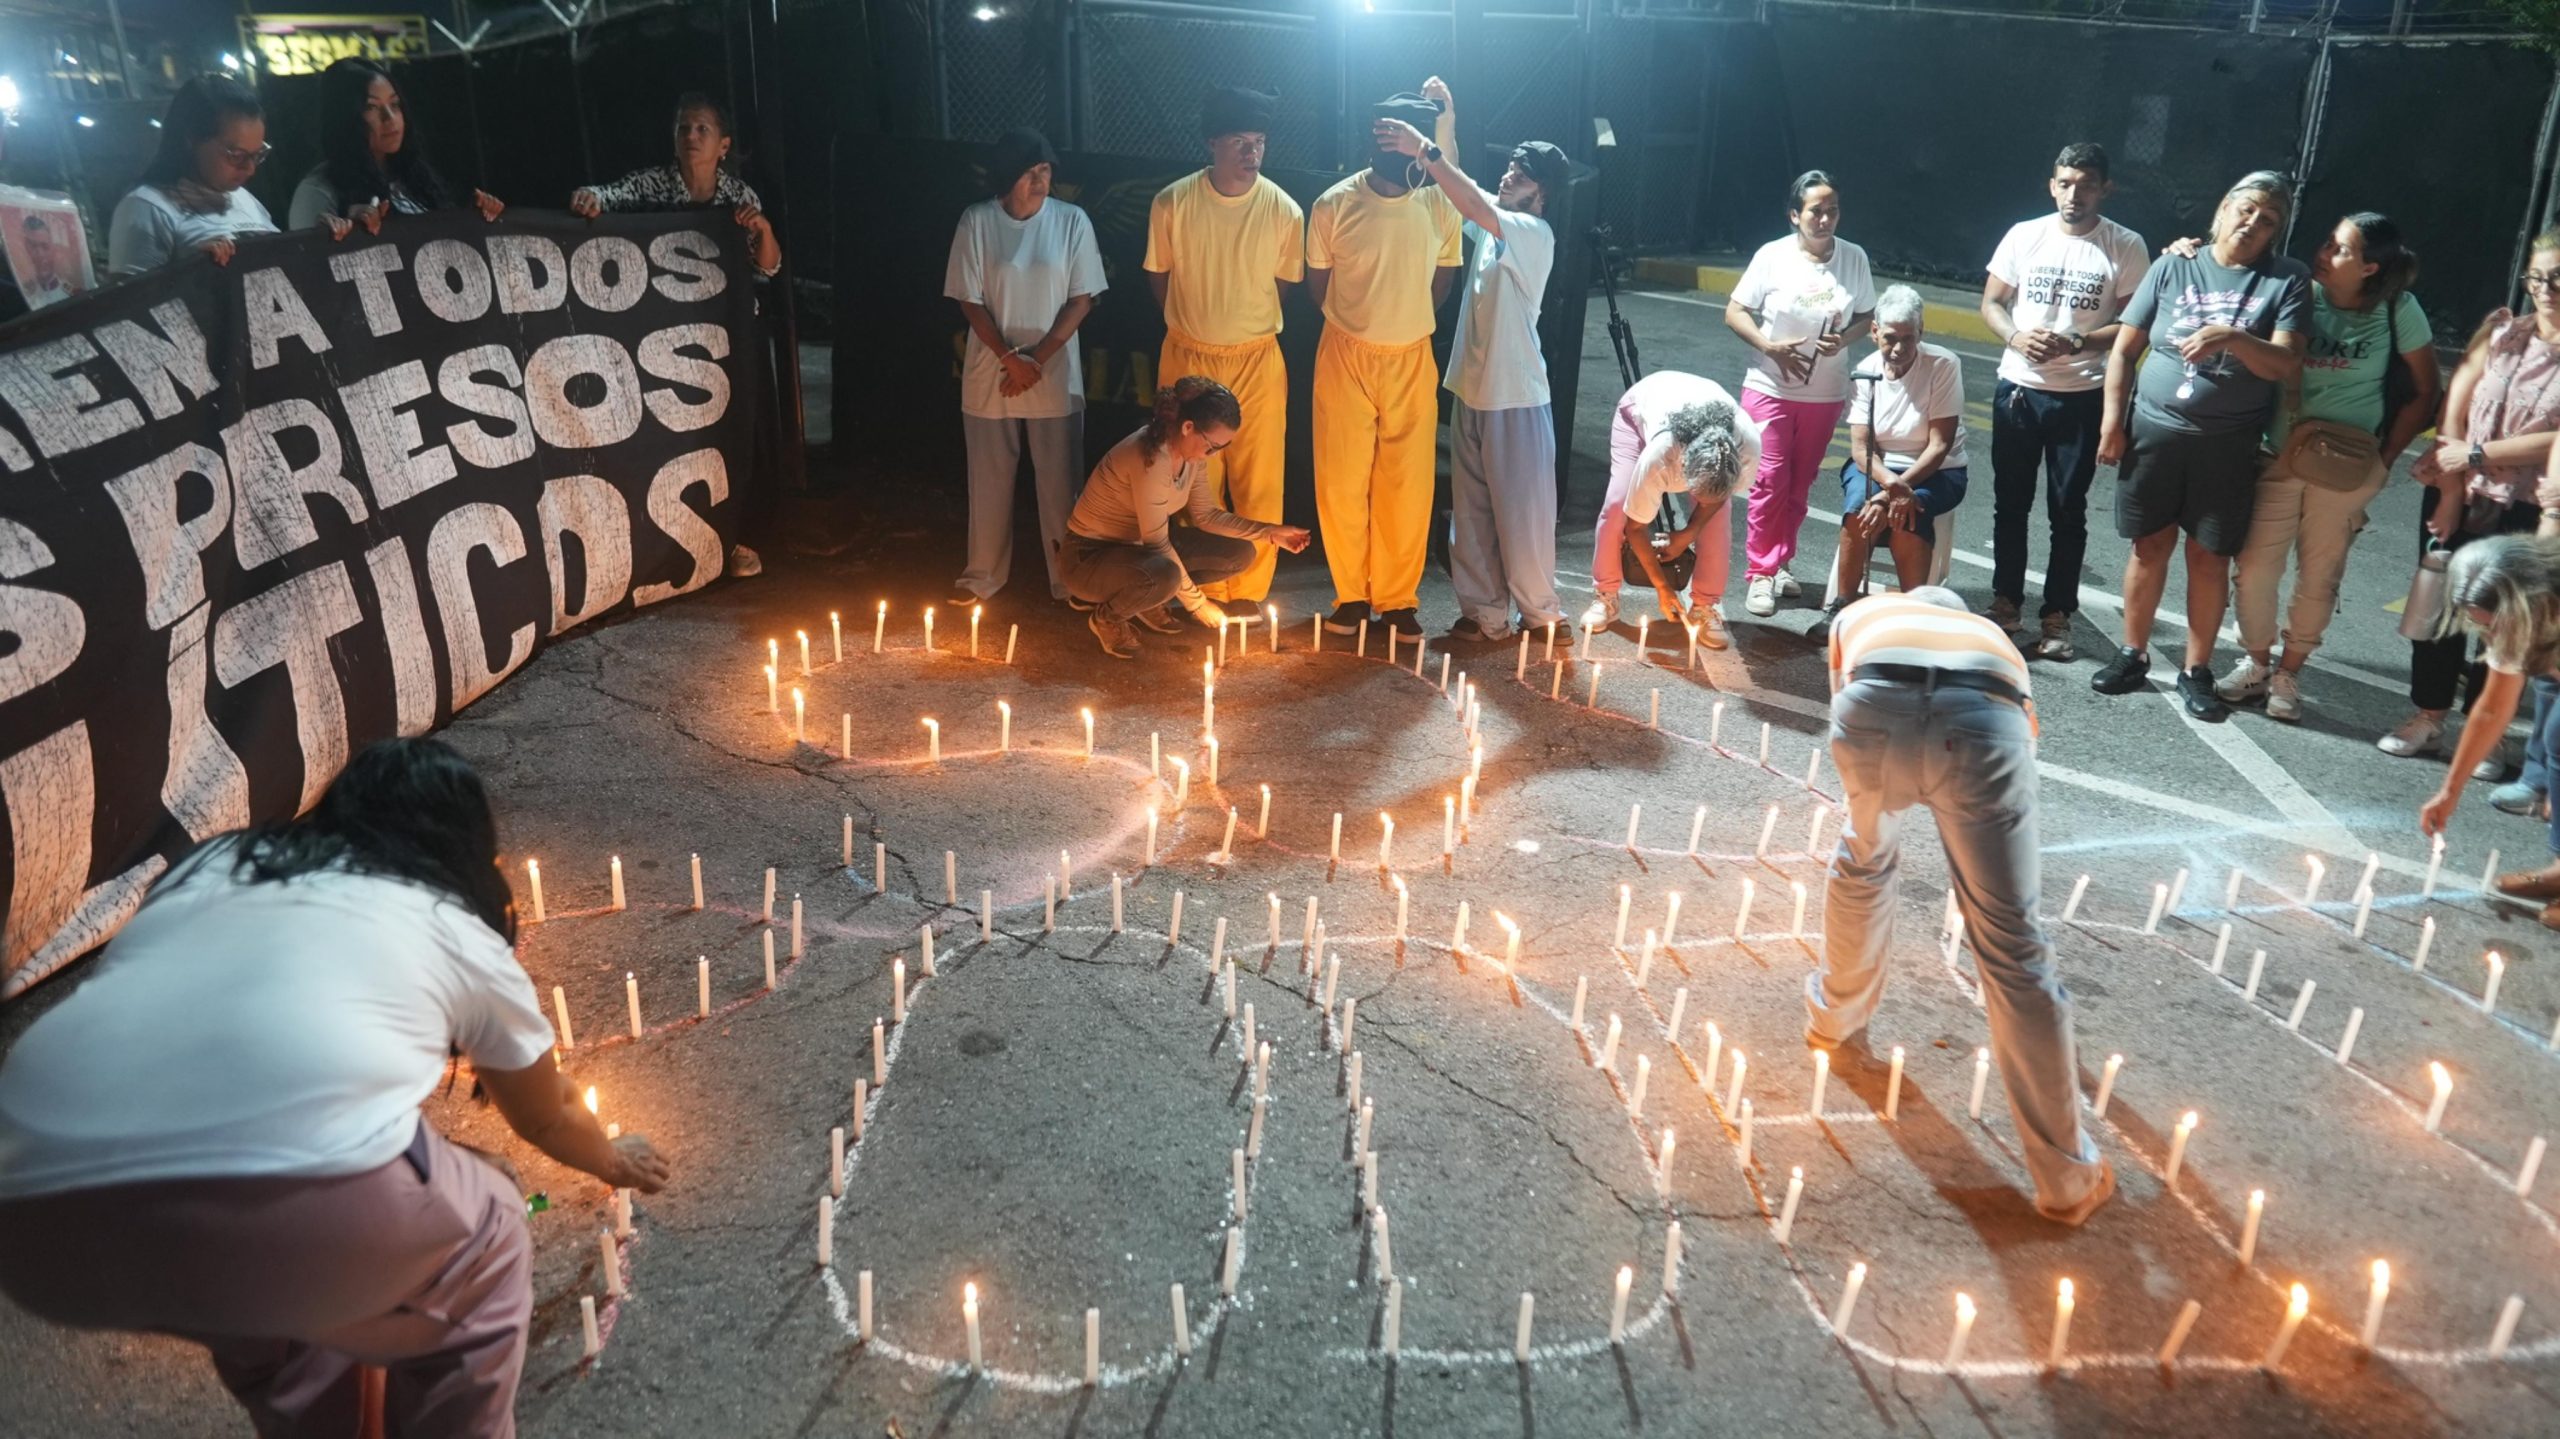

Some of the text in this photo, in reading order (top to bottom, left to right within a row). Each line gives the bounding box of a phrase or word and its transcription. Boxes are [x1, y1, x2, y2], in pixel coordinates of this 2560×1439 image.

[2027, 276, 2104, 296] LOS PRESOS
[2077, 270, 2106, 283] TODOS
[2027, 289, 2101, 311] POLÍTICOS
[0, 229, 728, 473] EN A TODOS
[2305, 336, 2372, 359] ORE
[103, 323, 731, 631] PRESOS
